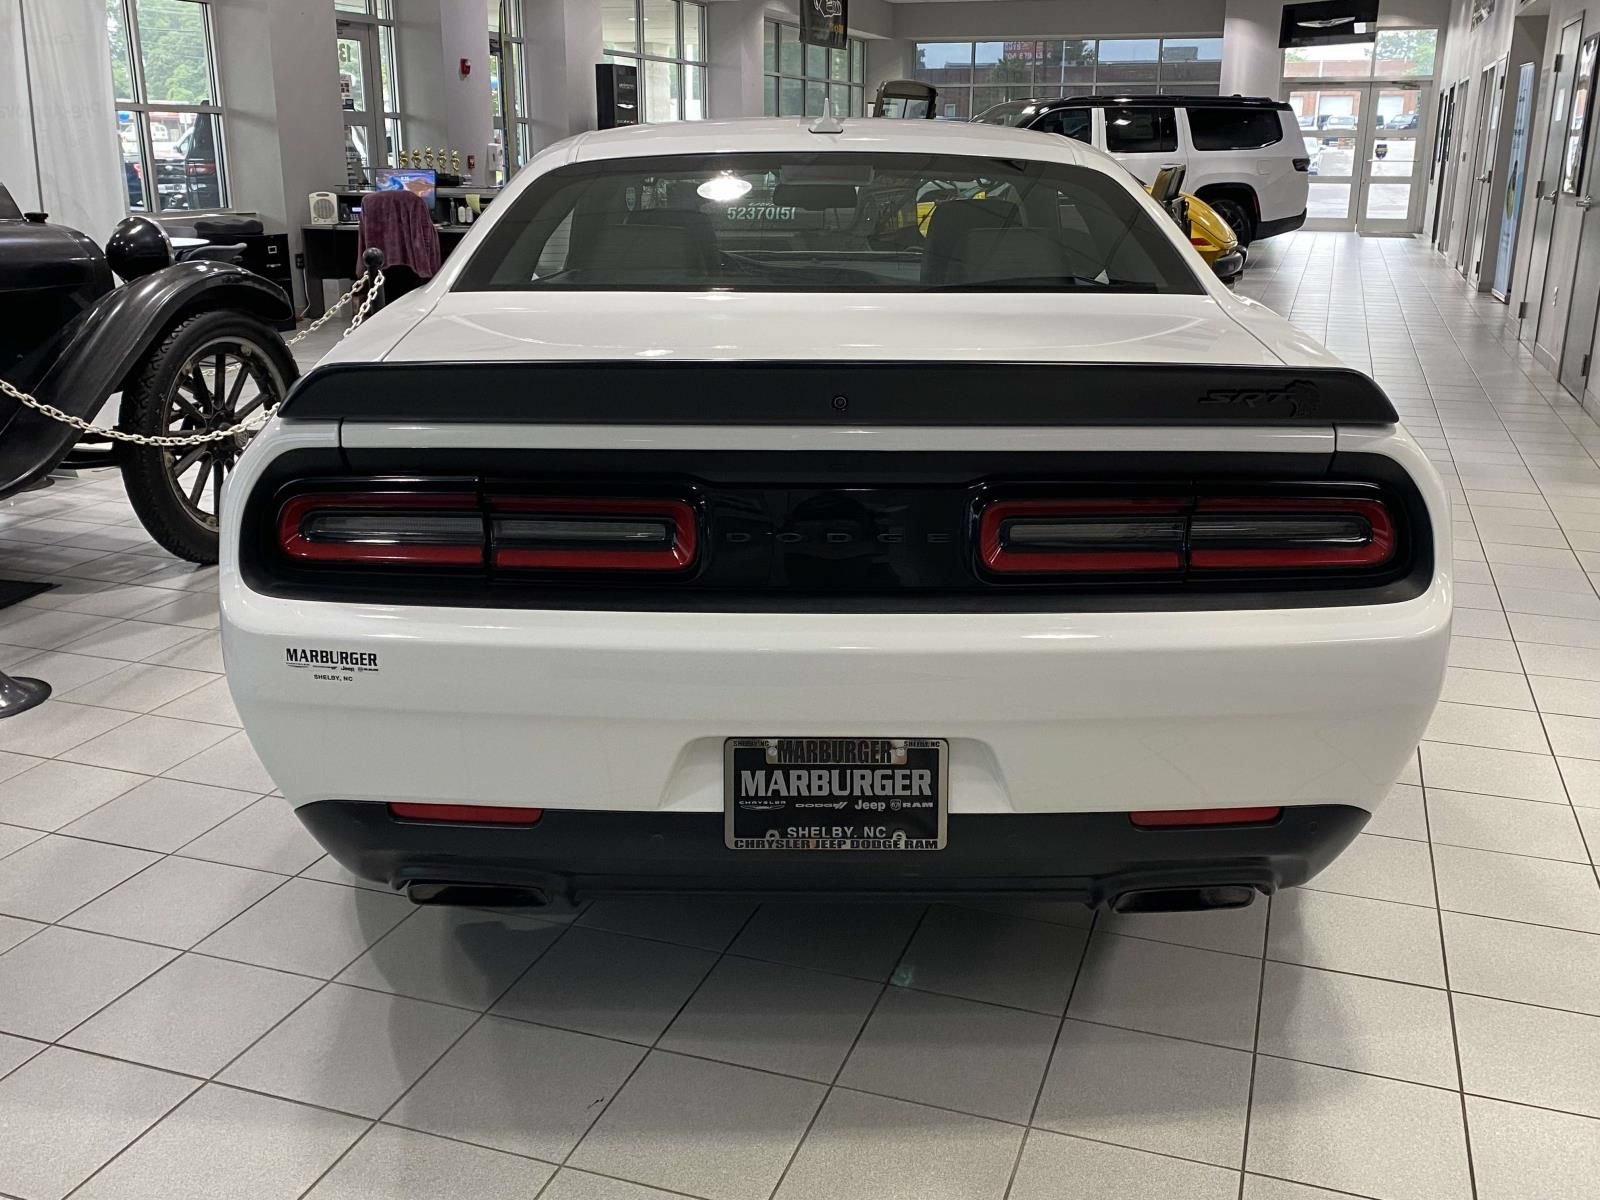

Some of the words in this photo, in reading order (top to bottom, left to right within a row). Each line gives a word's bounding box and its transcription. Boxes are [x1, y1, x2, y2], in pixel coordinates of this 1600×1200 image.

[727, 207, 796, 220] 52370151
[1198, 389, 1295, 408] SRT
[726, 531, 950, 544] DODGE
[286, 648, 378, 667] MARBURGER
[777, 740, 892, 763] MARBURGER
[741, 770, 932, 796] MARBURGER
[855, 800, 886, 811] Jeep
[863, 827, 887, 838] NC
[734, 840, 810, 849] CHRYSLER
[814, 840, 846, 849] JEEP
[851, 840, 900, 849] DODGE
[905, 840, 938, 849] RAM
